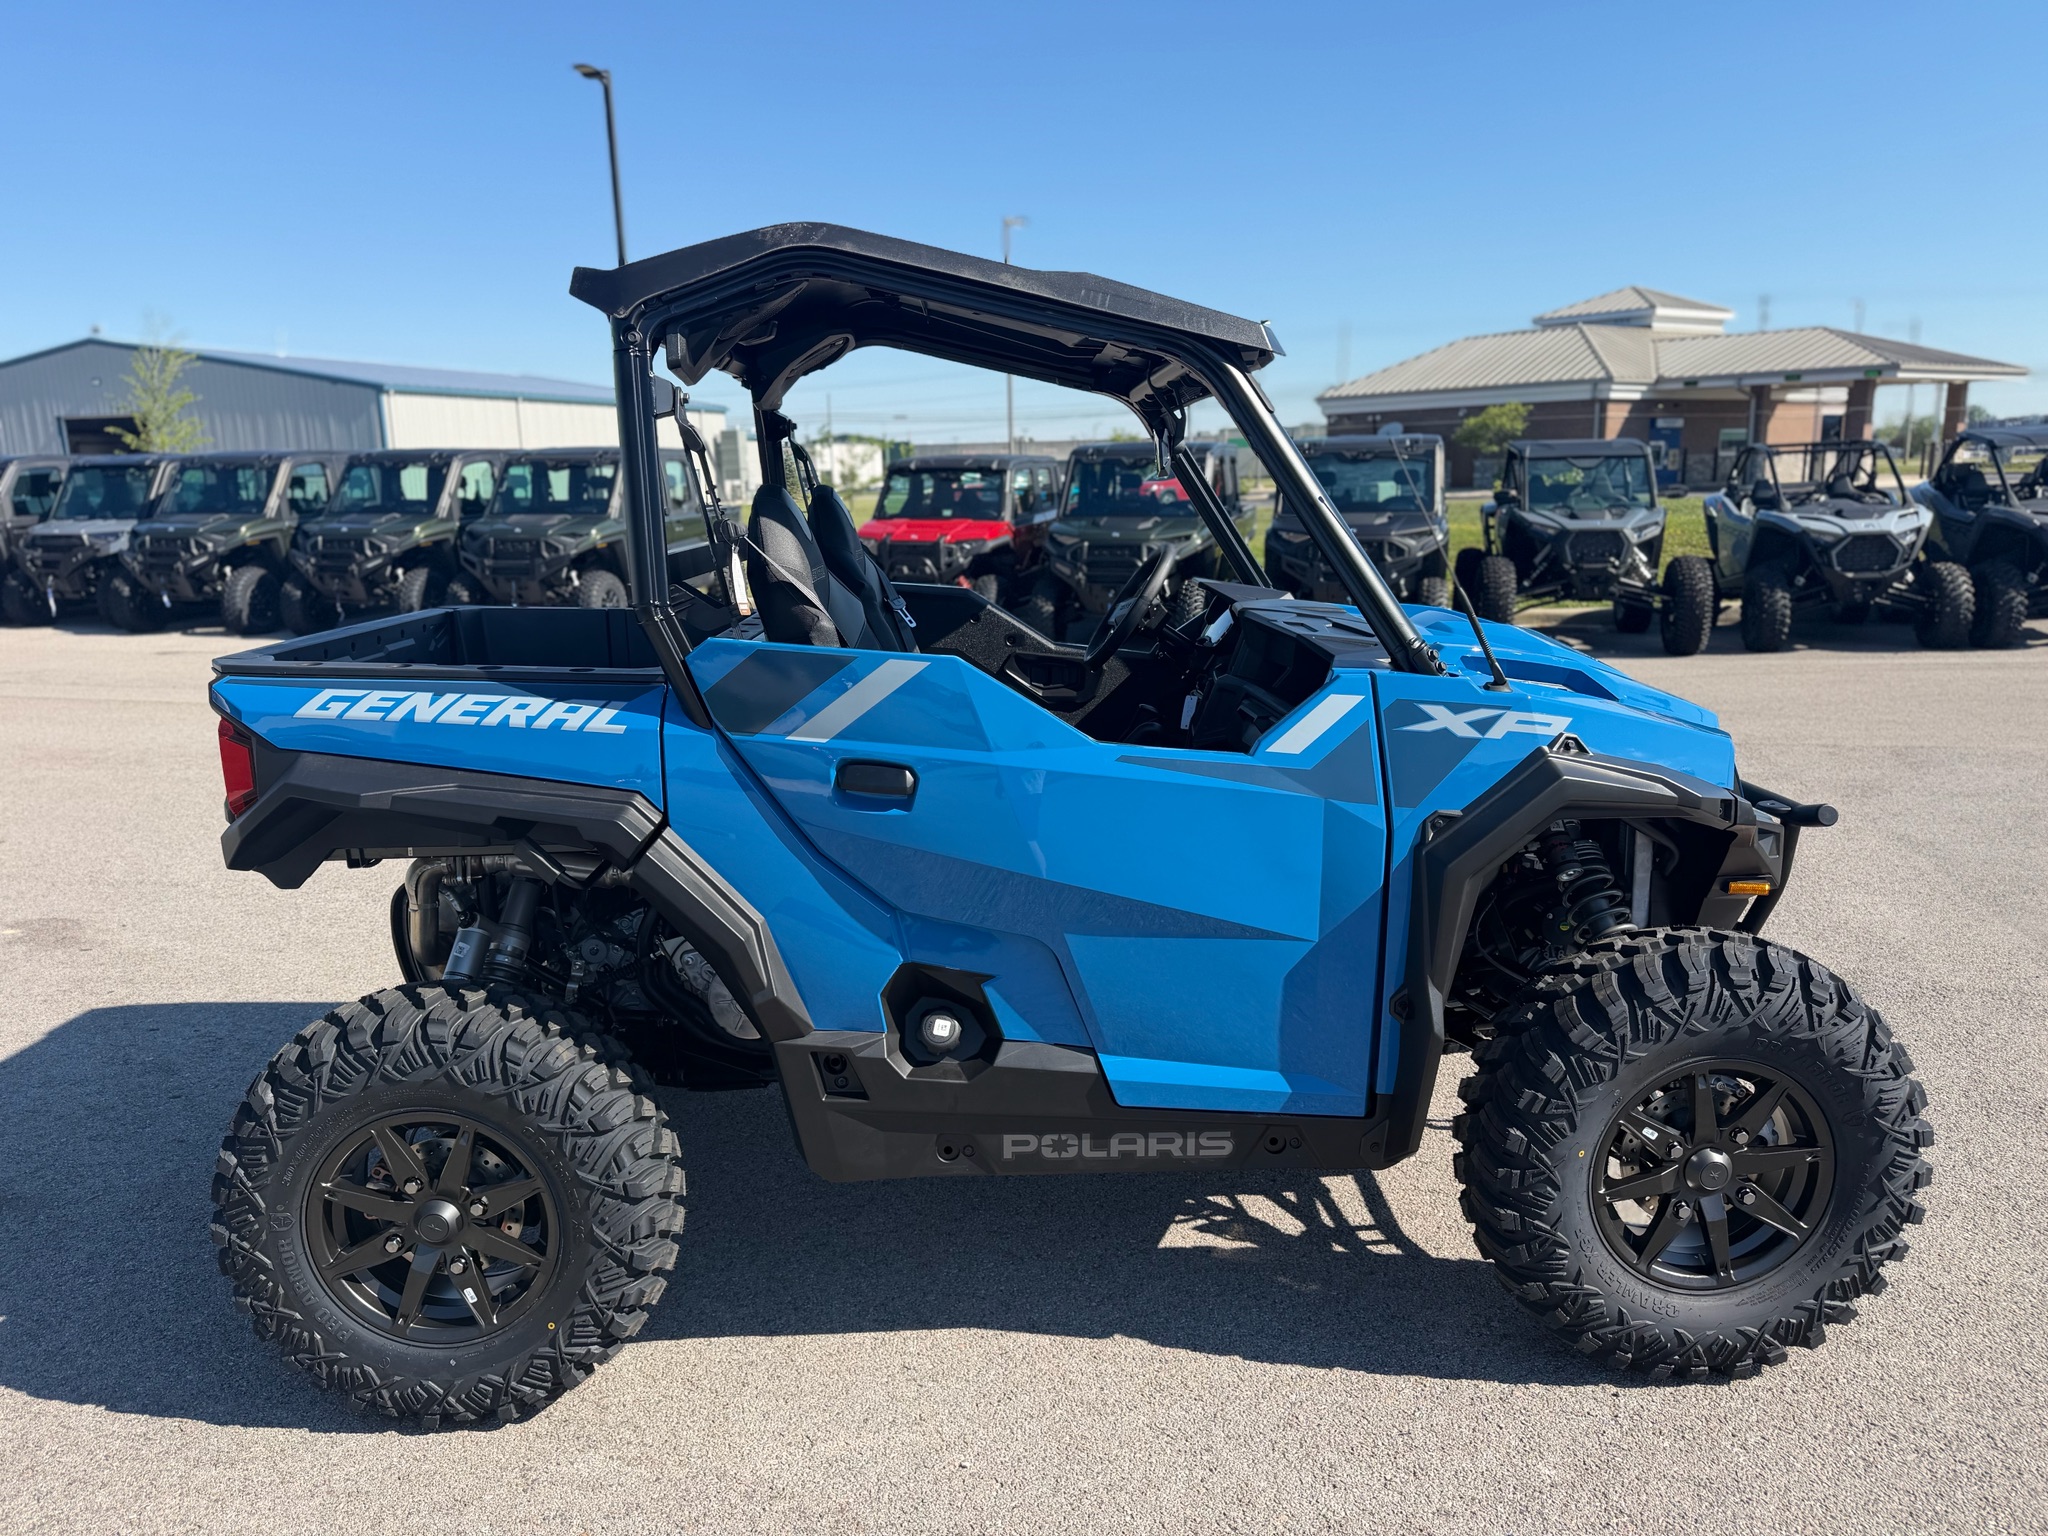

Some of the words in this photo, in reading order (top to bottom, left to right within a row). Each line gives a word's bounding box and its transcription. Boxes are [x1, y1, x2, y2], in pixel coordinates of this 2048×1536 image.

[293, 688, 627, 734] GENERAL
[1393, 703, 1573, 740] XP
[1001, 1131, 1235, 1160] POLARIS
[276, 1237, 320, 1307] ARMOR
[314, 1307, 355, 1345] PRO
